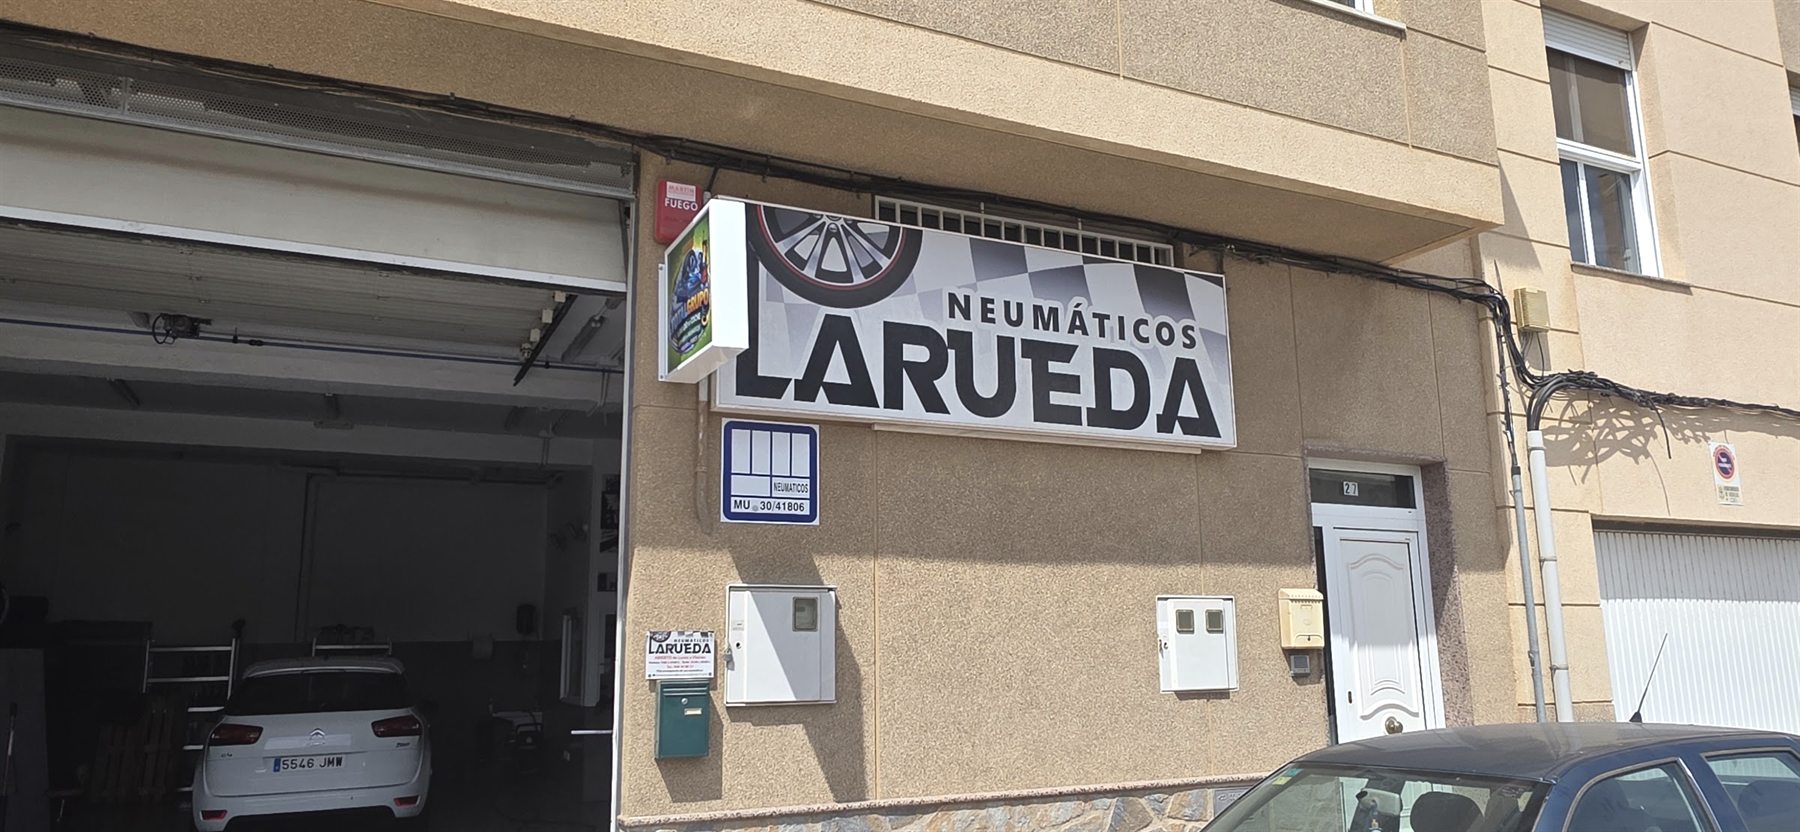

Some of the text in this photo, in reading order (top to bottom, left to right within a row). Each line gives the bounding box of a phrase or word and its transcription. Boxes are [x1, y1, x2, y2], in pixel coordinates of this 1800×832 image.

[665, 197, 698, 211] FUEGO
[687, 288, 709, 313] GRUPO
[948, 291, 1197, 349] NEUMÁTICOS
[736, 245, 1221, 438] LARUEDA
[1344, 482, 1357, 495] 27
[733, 499, 805, 512] MU 30/41806
[649, 636, 711, 654] LARUEDA
[281, 756, 343, 770] 5546 JMW
